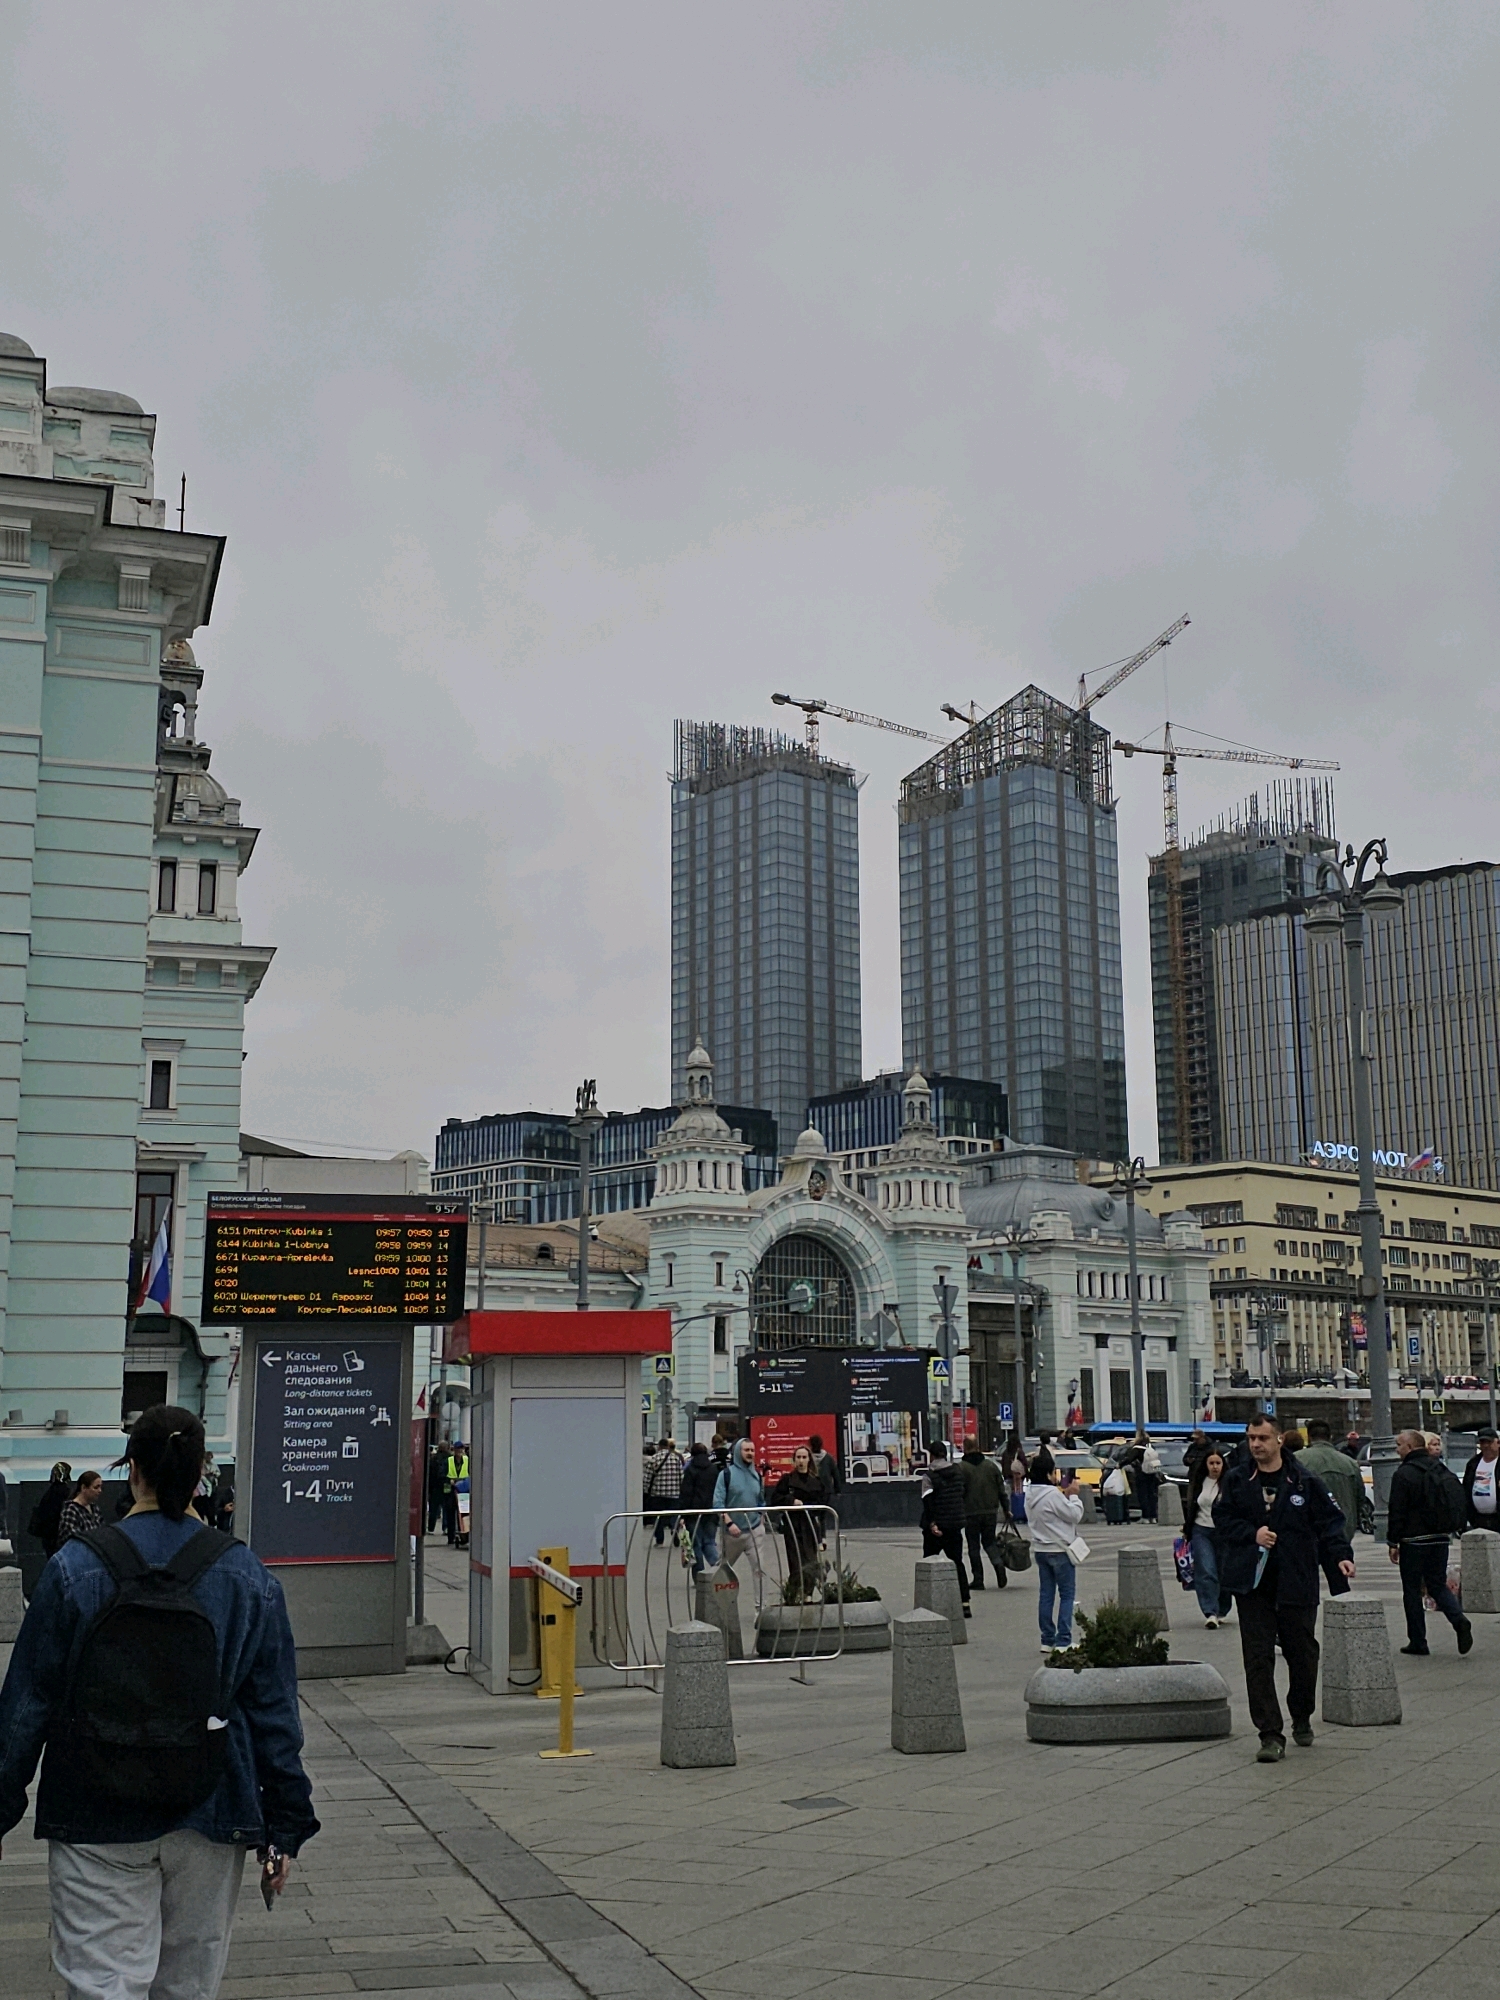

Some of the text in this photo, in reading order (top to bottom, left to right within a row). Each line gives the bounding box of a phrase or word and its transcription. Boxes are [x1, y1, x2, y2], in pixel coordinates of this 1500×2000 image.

[1313, 1140, 1407, 1168] АЭРОЛОТ
[215, 1279, 238, 1287] 6020
[214, 1292, 237, 1300] 6020
[405, 1293, 429, 1301] 10:04
[213, 1305, 236, 1313] 6673
[240, 1306, 276, 1314] ородок
[287, 1351, 320, 1360] Кассы
[285, 1365, 338, 1374] дальнего
[286, 1377, 351, 1386] следования
[285, 1389, 344, 1399] Long-distance
[284, 1406, 365, 1416] Зал ожидания
[1003, 1405, 1010, 1418] P
[284, 1421, 311, 1429] Sitting
[283, 1437, 326, 1448] Камера
[282, 1451, 337, 1461] хранения
[282, 1463, 329, 1471] Cloakroom
[327, 1480, 353, 1492] Пути
[282, 1480, 322, 1503] 1-4
[327, 1494, 352, 1502] Tracks
